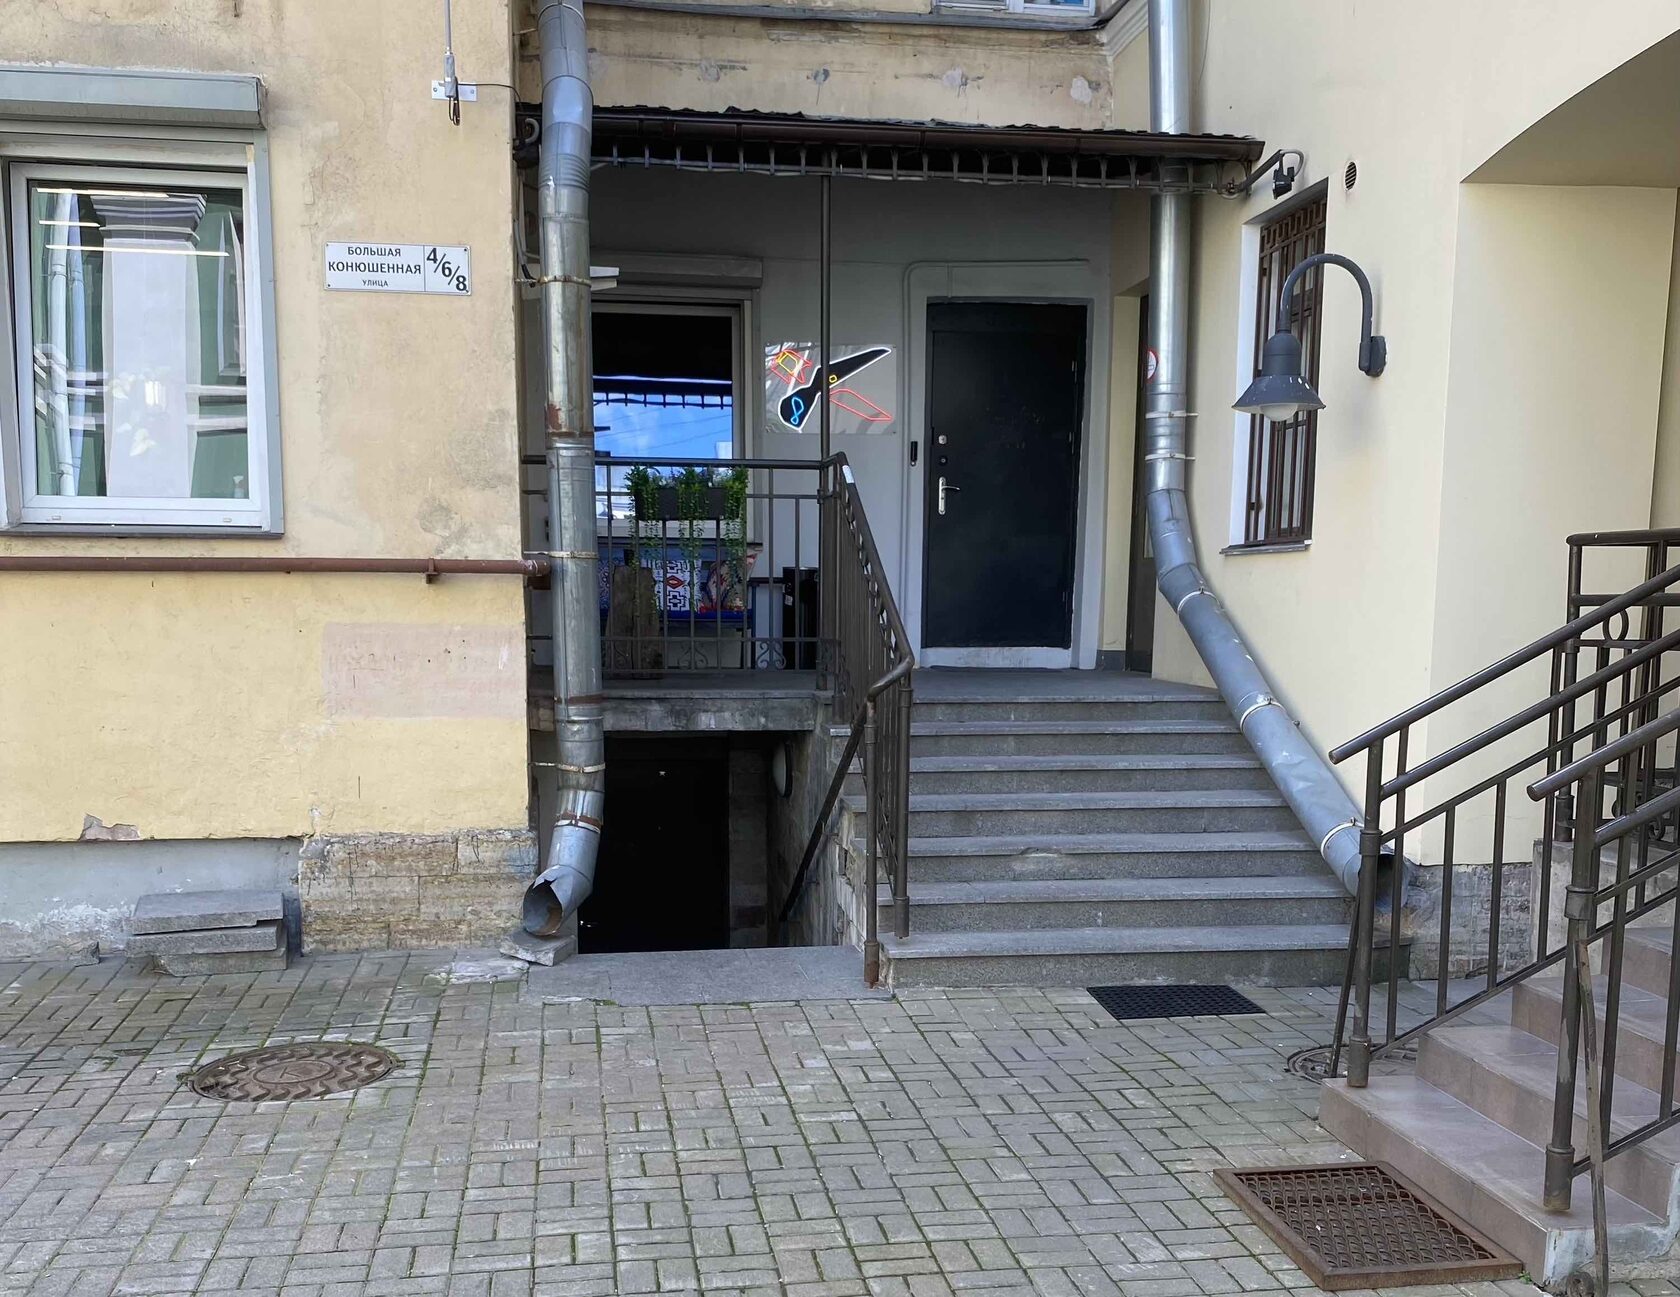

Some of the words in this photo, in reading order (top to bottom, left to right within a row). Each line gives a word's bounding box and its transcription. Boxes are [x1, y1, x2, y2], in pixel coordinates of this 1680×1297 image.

[347, 246, 401, 257] БОЛЬШАЯ
[328, 261, 421, 274] КОНЮШЕННАЯ
[426, 247, 467, 292] 4/6/8
[362, 279, 389, 287] УЛИЦА
